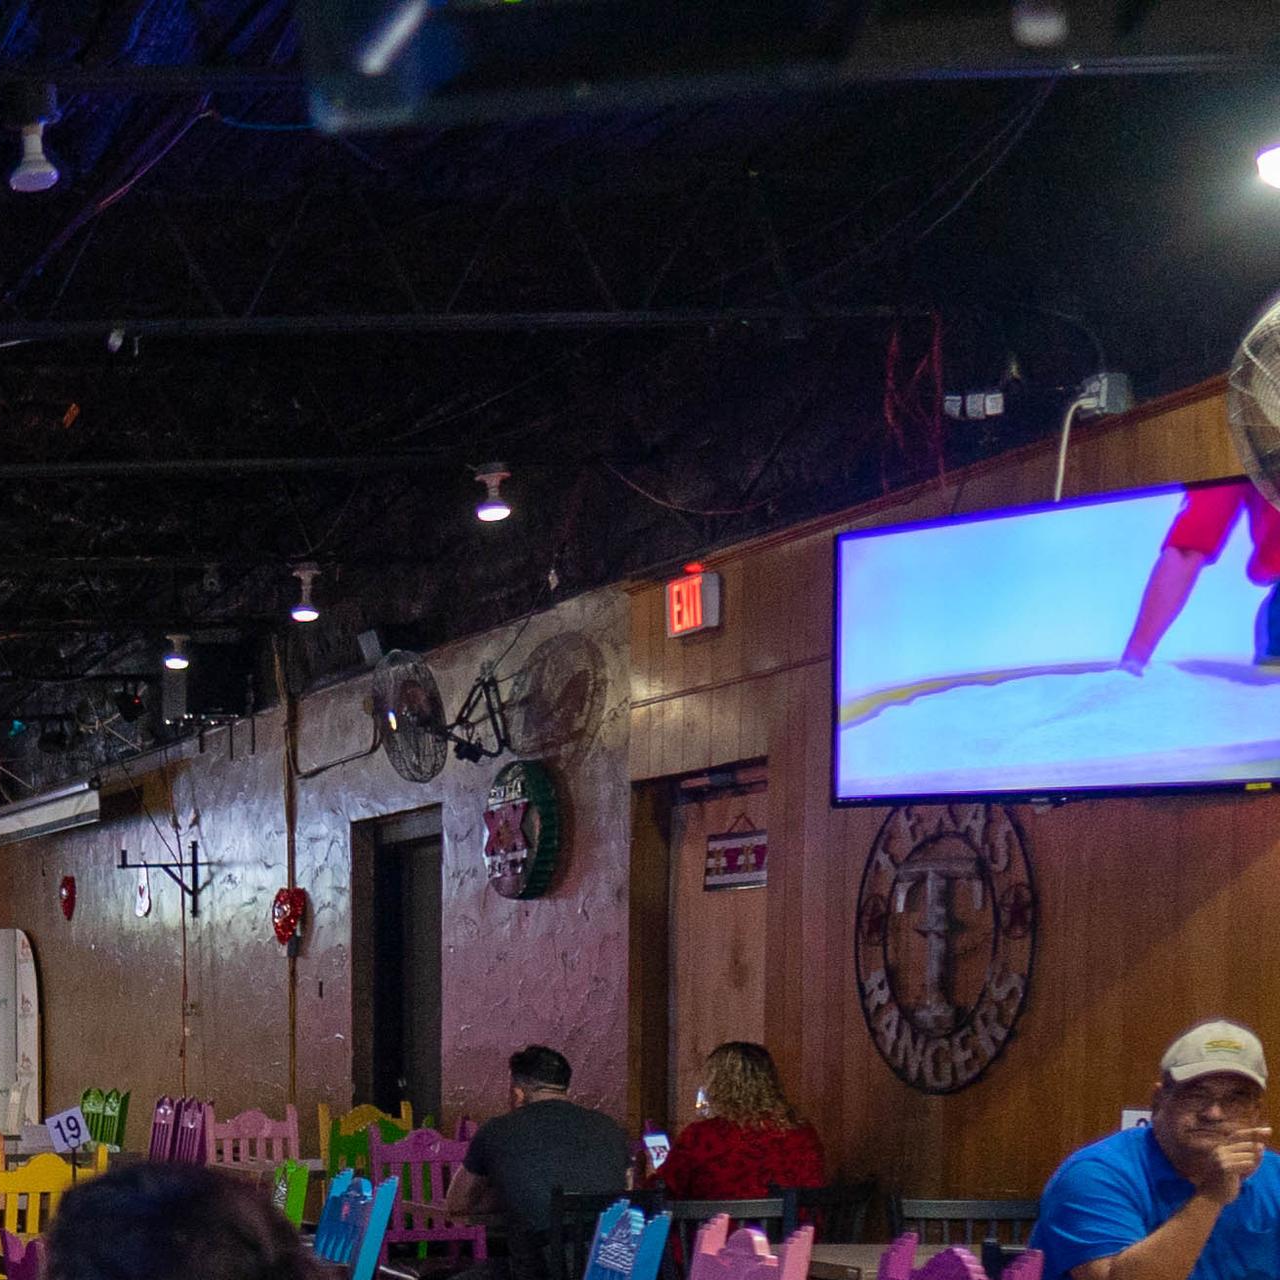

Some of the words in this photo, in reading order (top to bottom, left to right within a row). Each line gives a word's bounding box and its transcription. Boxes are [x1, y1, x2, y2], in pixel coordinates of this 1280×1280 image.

[672, 576, 702, 632] EXIT
[863, 958, 1027, 1090] RANGERS
[54, 1115, 82, 1144] 19
